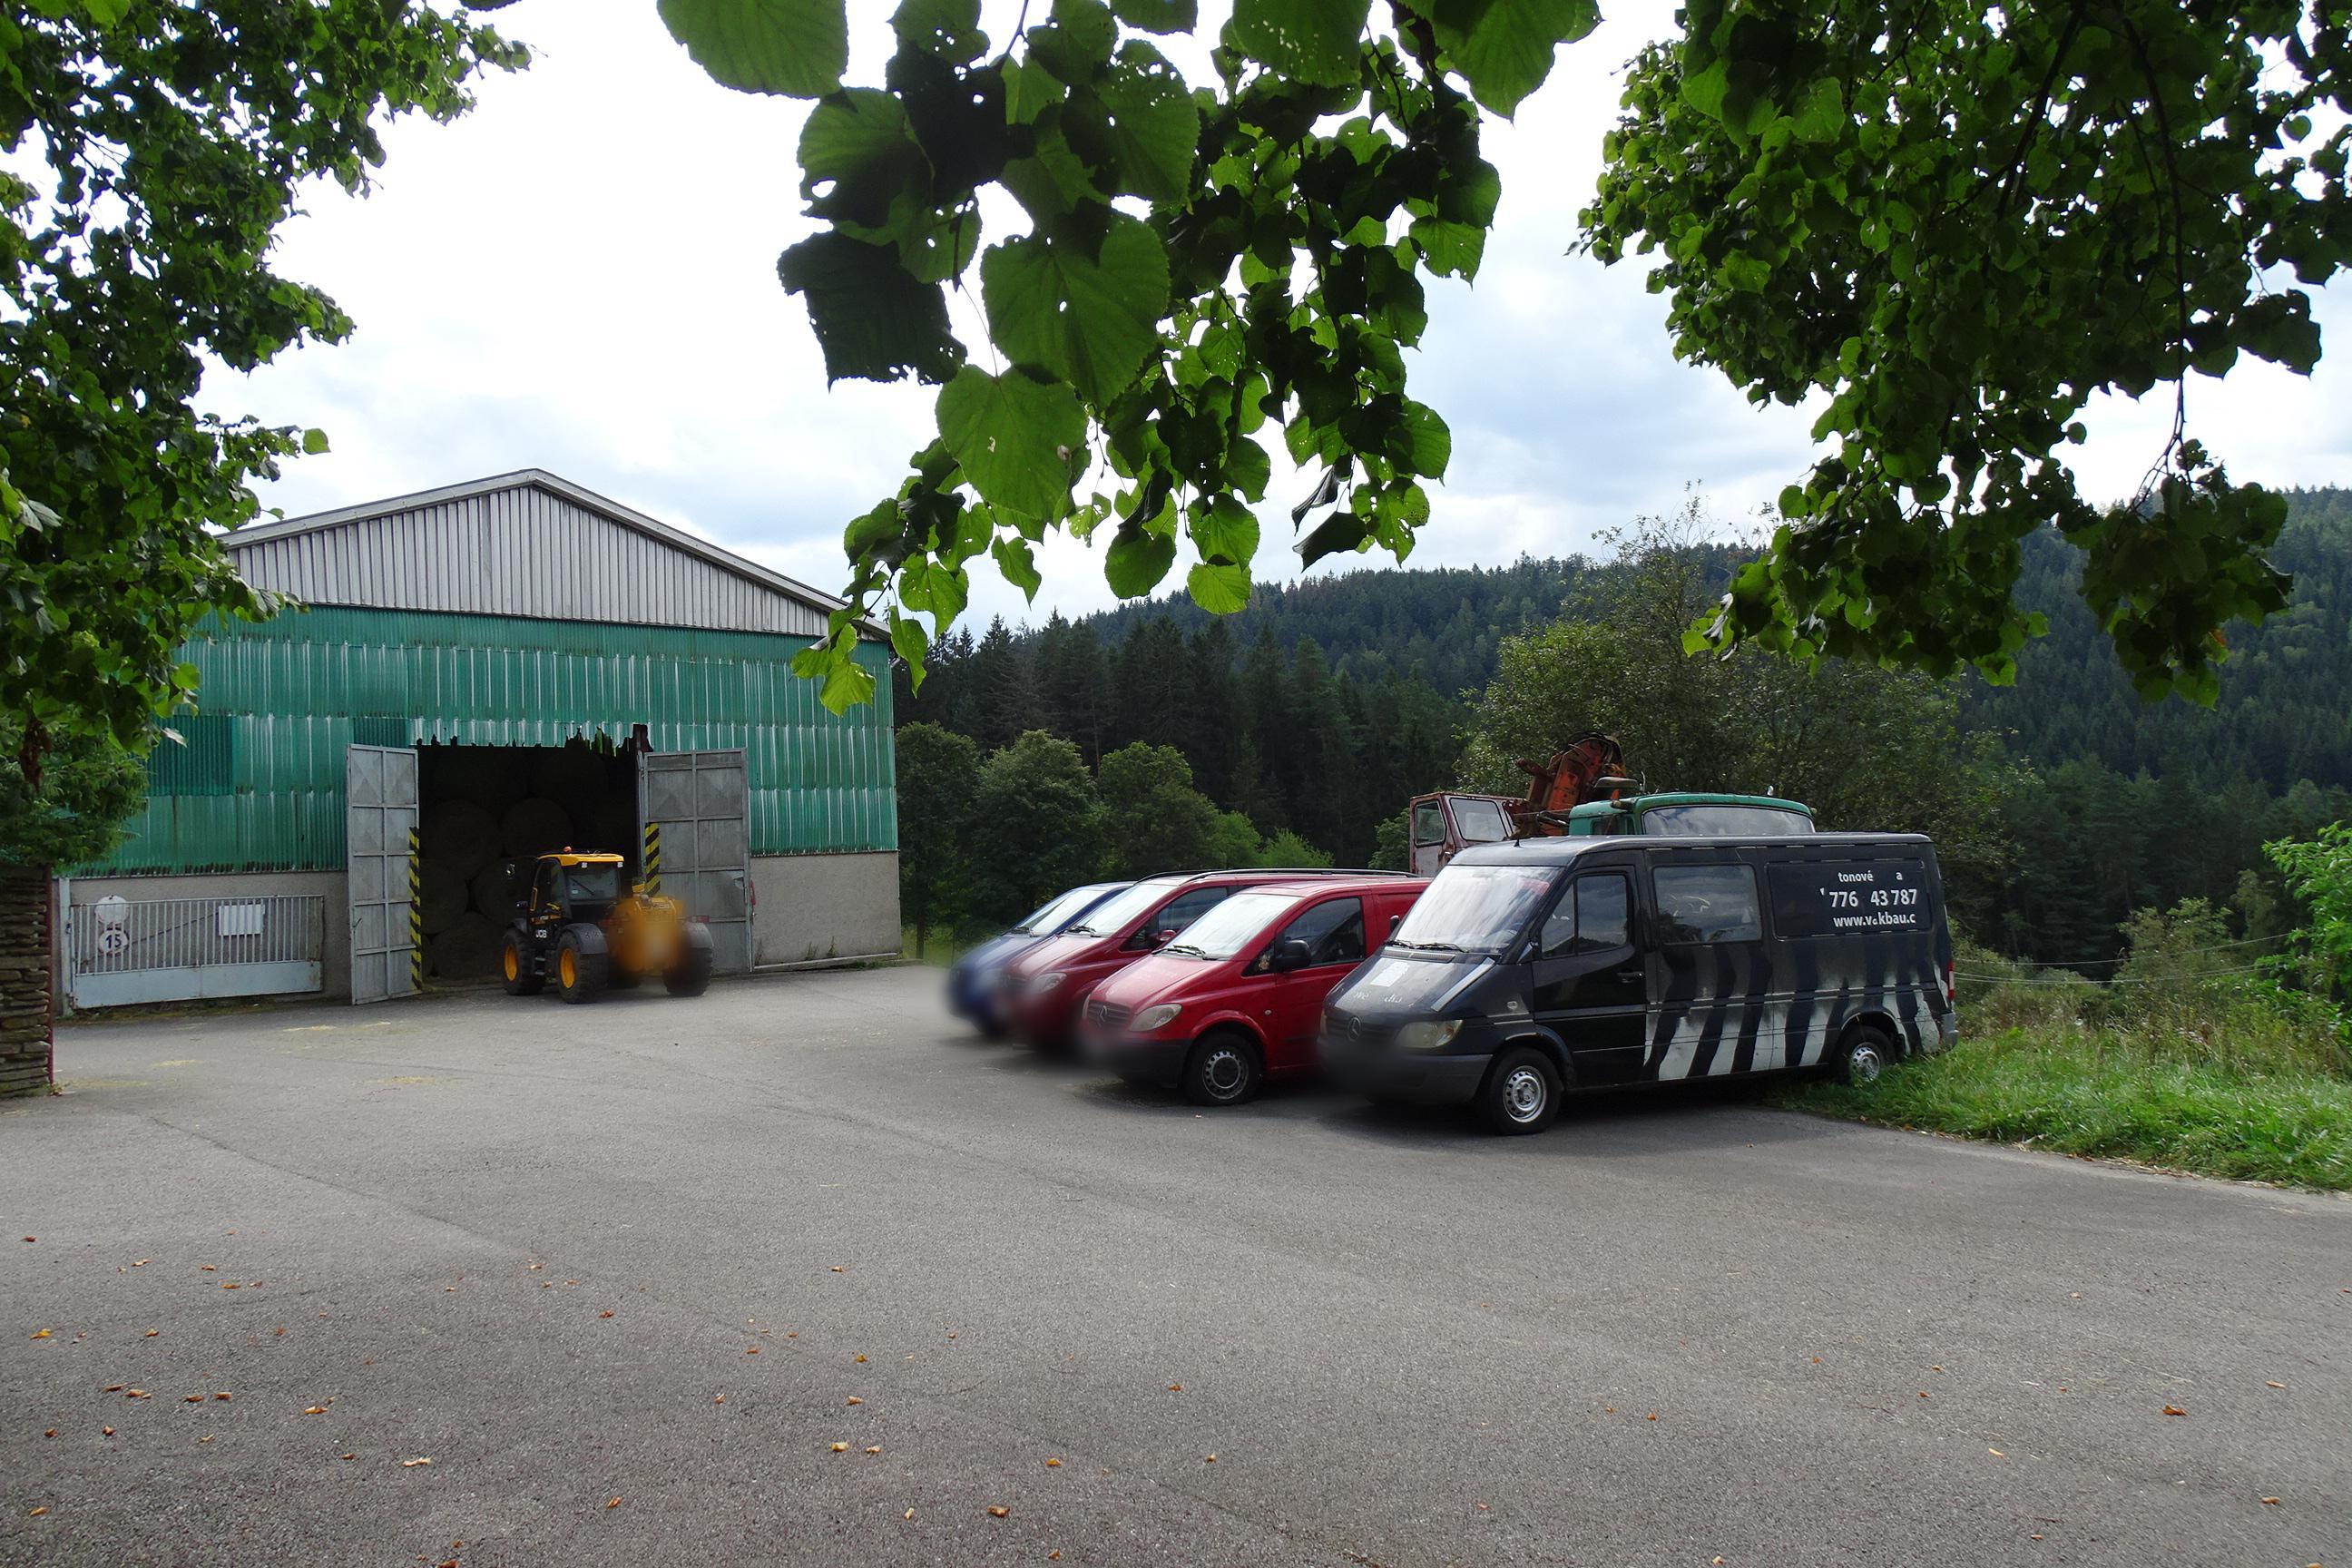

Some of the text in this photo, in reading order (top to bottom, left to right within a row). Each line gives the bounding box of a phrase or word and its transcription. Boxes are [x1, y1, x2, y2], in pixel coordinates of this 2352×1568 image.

[1838, 870, 1874, 882] tonové
[1828, 891, 1858, 907] 776
[1890, 888, 1917, 906] 787
[105, 934, 122, 949] 15
